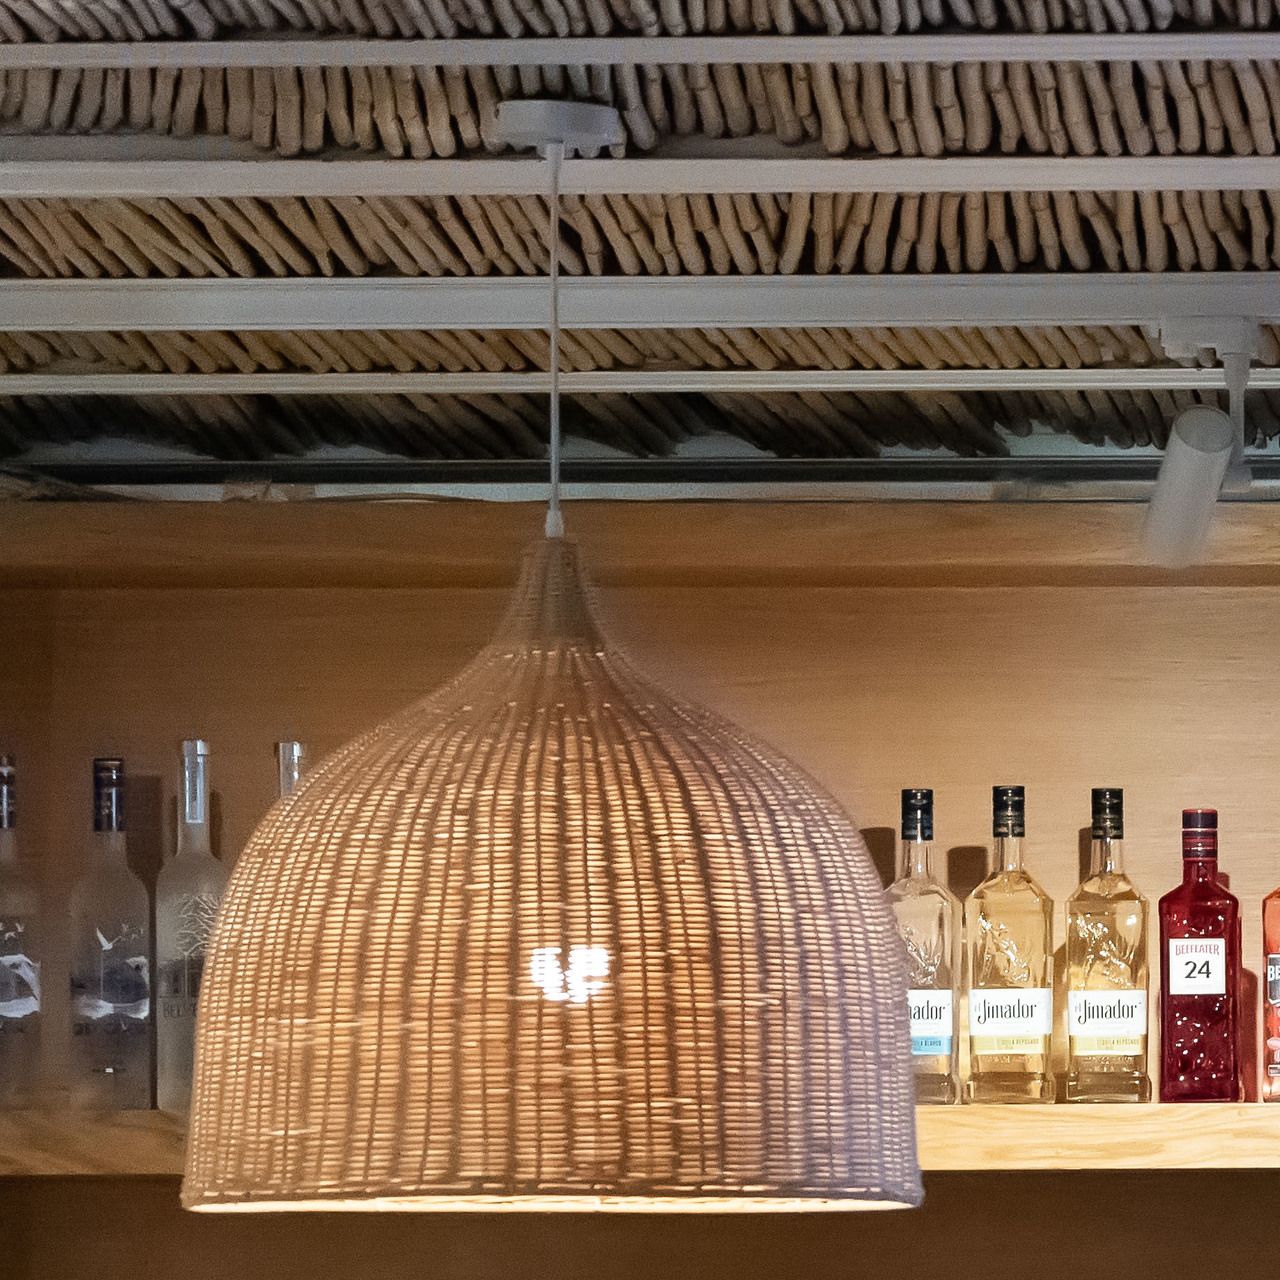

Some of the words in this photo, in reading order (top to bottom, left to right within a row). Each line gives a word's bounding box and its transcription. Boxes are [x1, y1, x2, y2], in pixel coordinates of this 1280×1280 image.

[1175, 944, 1219, 956] BEEFEATER
[1184, 960, 1212, 979] 24
[977, 998, 1037, 1025] Jimador
[1078, 999, 1138, 1025] Jimador
